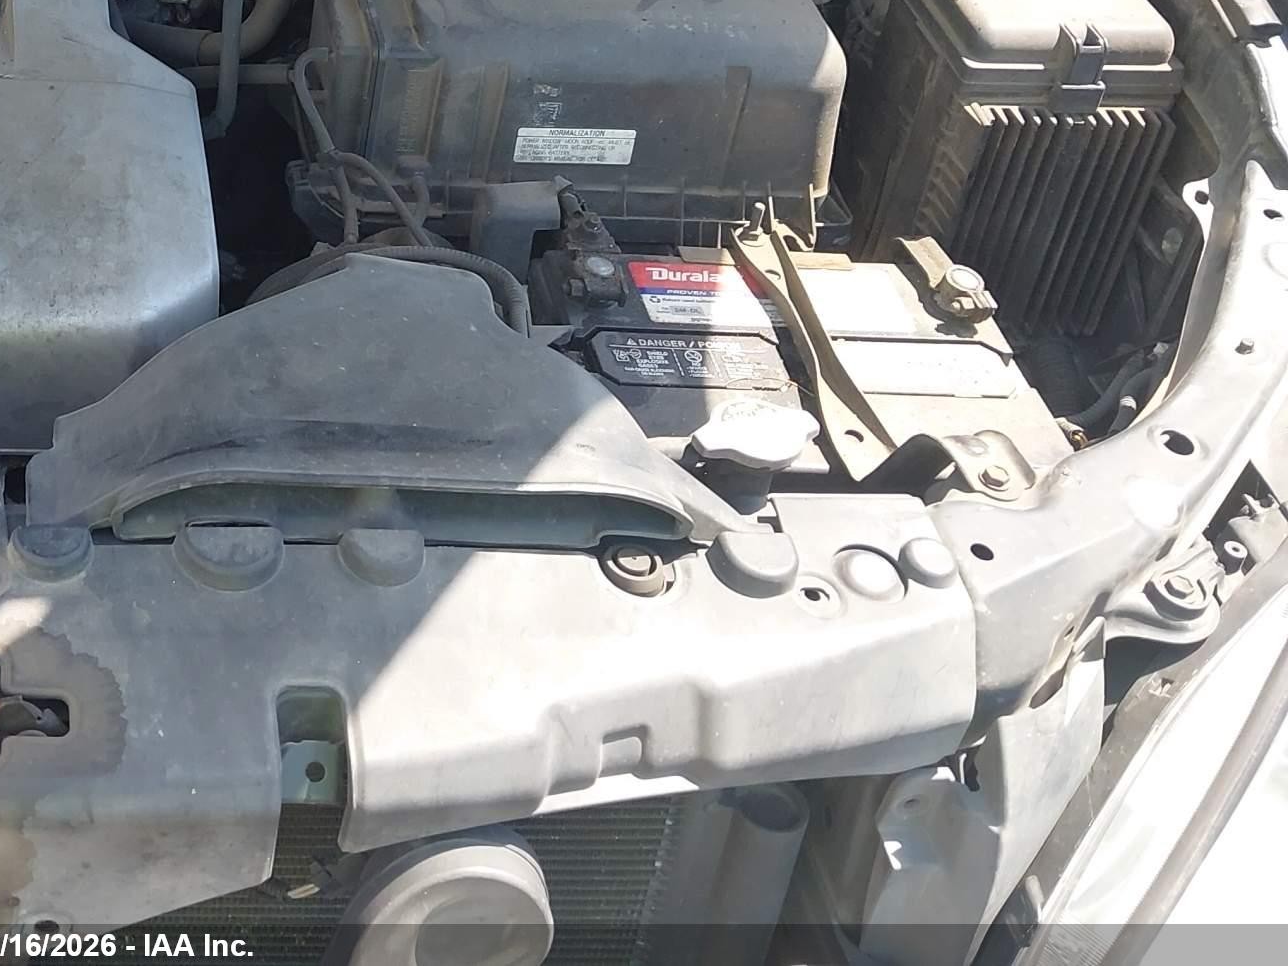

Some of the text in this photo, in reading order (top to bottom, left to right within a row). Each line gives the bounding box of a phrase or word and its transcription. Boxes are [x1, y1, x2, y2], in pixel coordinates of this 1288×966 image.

[548, 129, 606, 137] NORMALIZATION
[645, 266, 722, 283] Durala
[638, 338, 687, 348] DANGER
